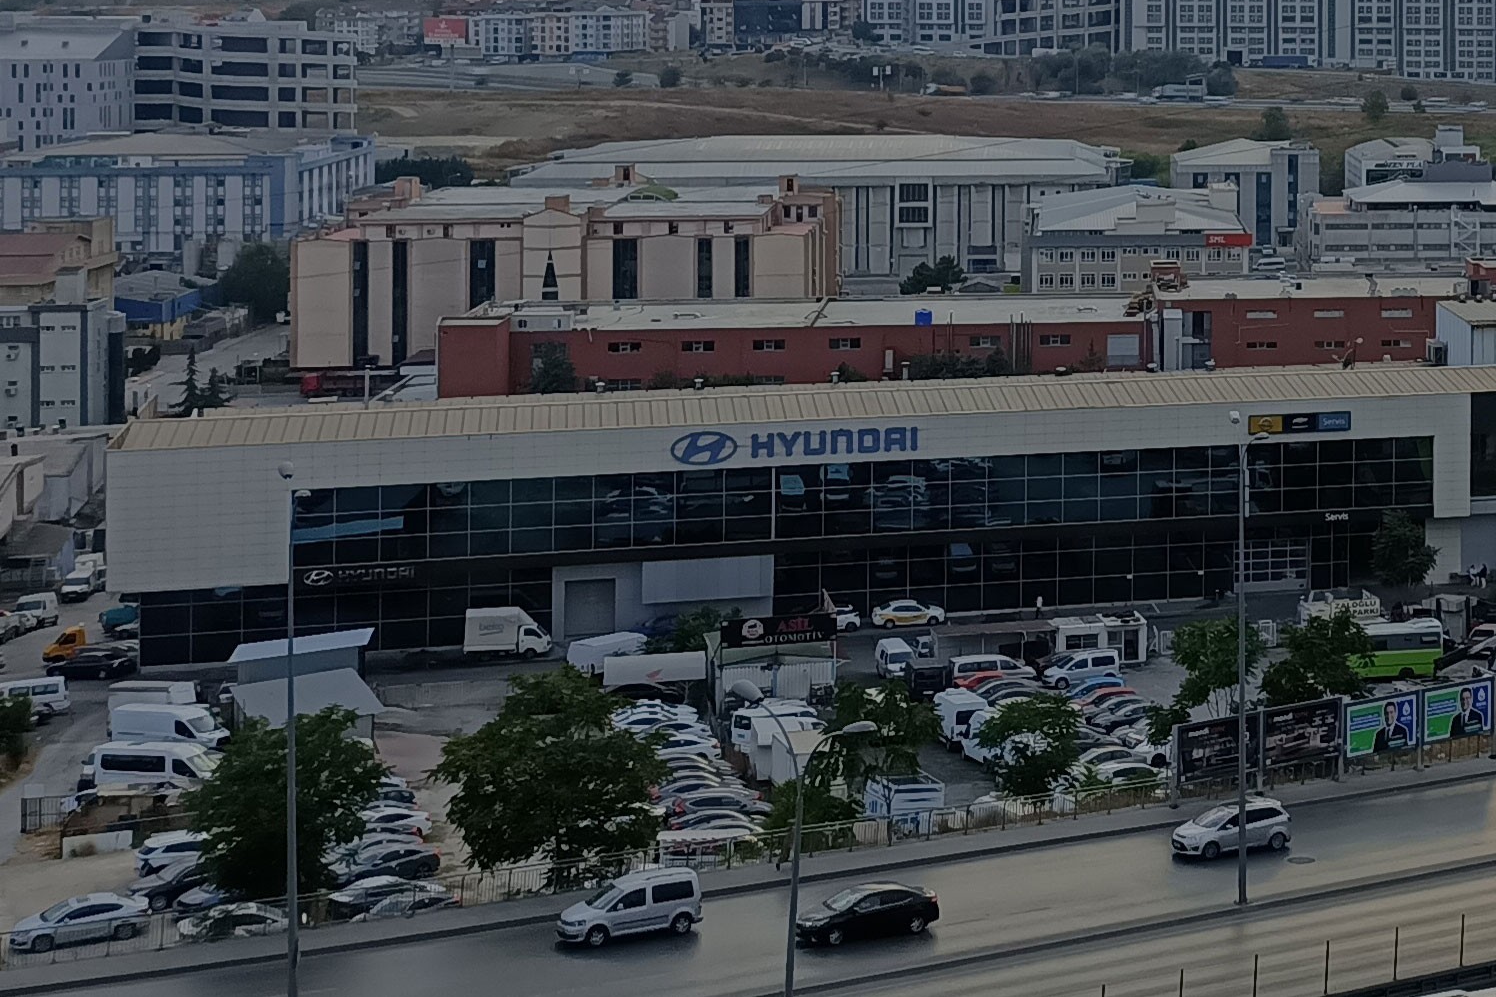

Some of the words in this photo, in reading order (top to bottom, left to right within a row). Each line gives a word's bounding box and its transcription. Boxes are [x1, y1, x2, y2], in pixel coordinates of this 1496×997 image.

[1322, 417, 1348, 426] Servis
[751, 426, 919, 459] HYUNDAI
[1325, 511, 1349, 521] Servis
[338, 566, 416, 583] HYUNDAI
[764, 630, 826, 644] OTOMOTİV
